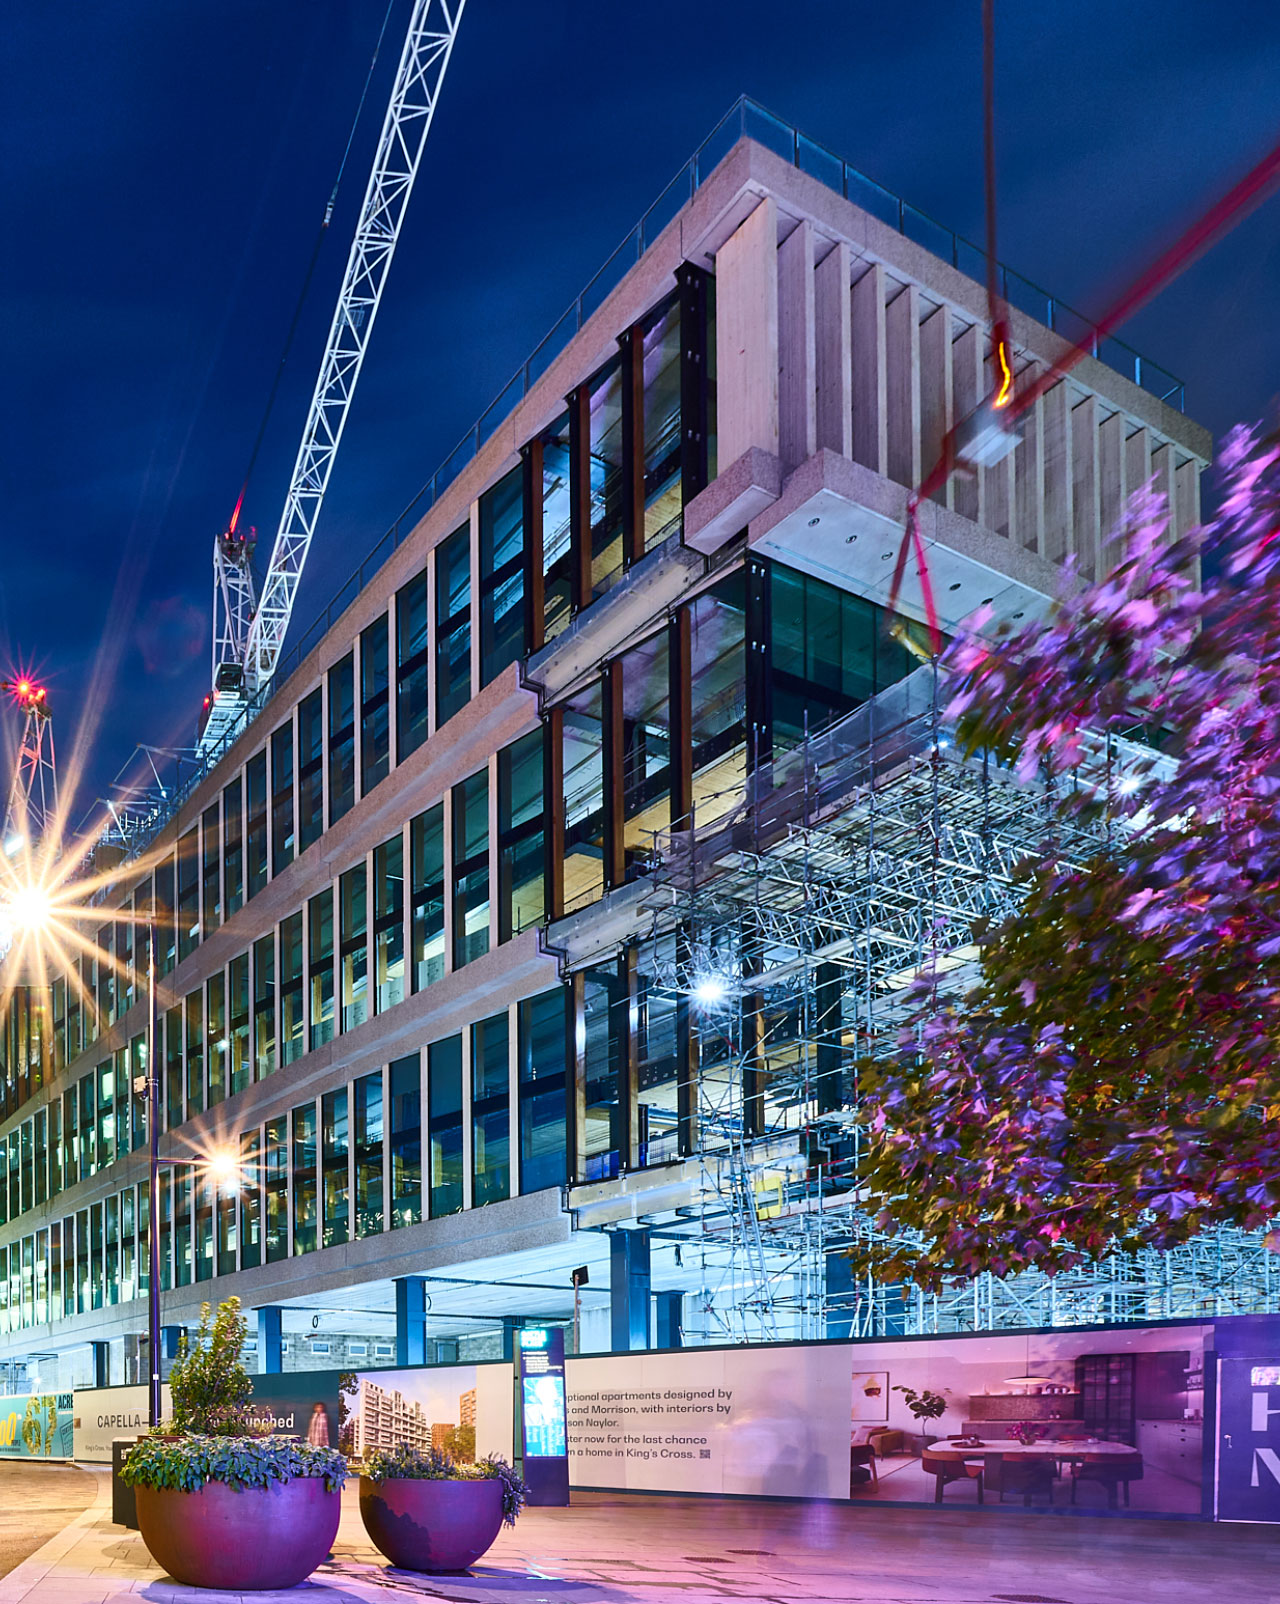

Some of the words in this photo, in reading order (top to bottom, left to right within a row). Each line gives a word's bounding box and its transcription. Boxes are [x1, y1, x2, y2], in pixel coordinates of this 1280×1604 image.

[601, 1391, 661, 1402] apartments
[663, 1389, 715, 1401] designed
[718, 1389, 732, 1400] by
[571, 1405, 589, 1413] and
[591, 1405, 639, 1414] Morrison,
[641, 1404, 664, 1413] with
[666, 1404, 714, 1413] interiors
[716, 1403, 731, 1414] by
[22, 1396, 58, 1456] 67
[97, 1414, 141, 1428] CAPELLA
[585, 1418, 619, 1429] Naylor.
[607, 1434, 622, 1443] for
[624, 1435, 640, 1444] the
[642, 1435, 663, 1444] last
[664, 1434, 707, 1444] chance
[585, 1447, 613, 1457] home
[615, 1448, 624, 1457] in
[626, 1448, 658, 1460] King's
[660, 1448, 696, 1458] Cross.
